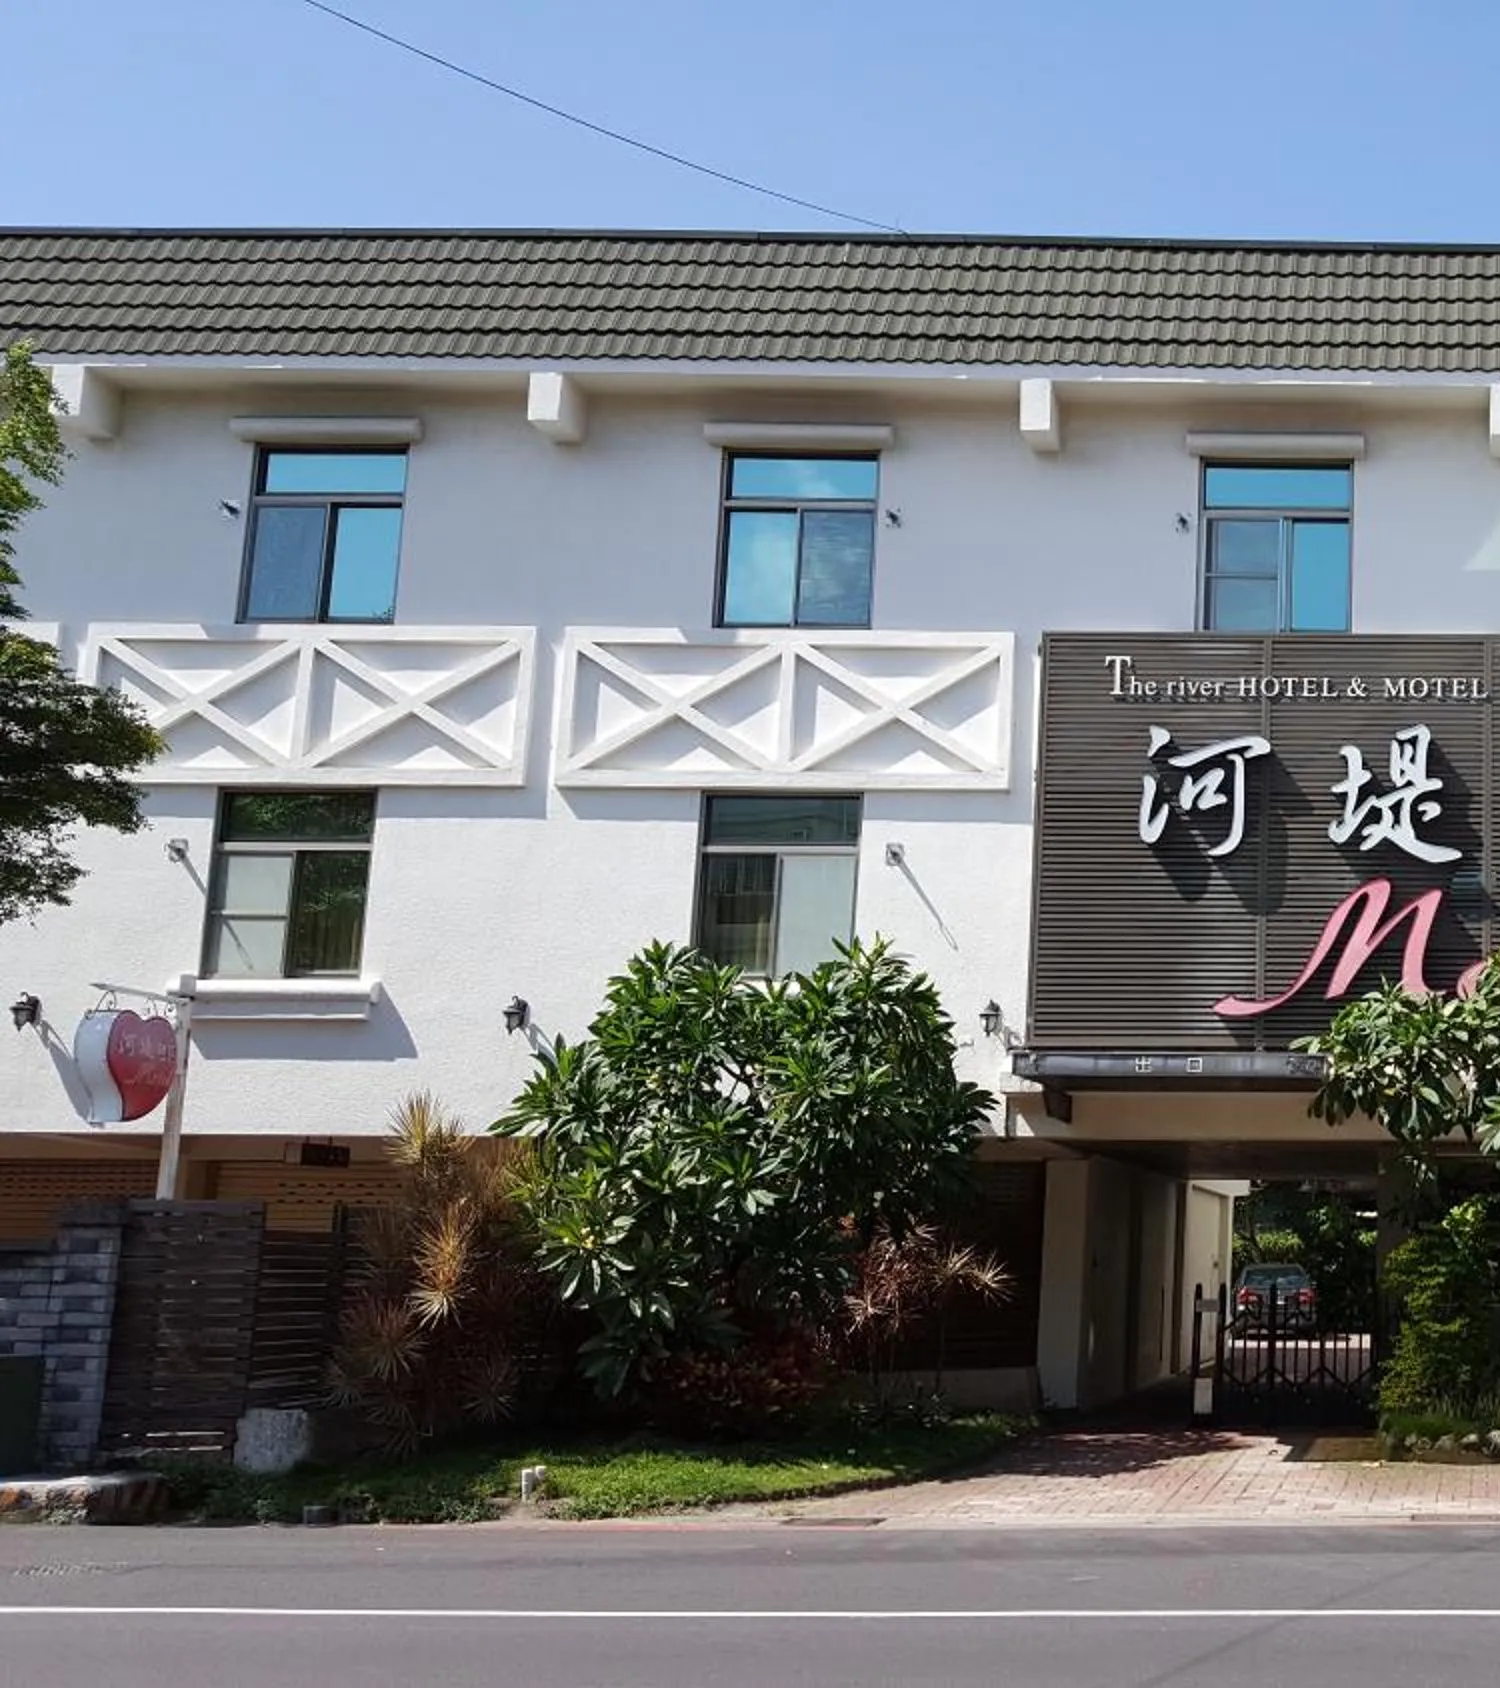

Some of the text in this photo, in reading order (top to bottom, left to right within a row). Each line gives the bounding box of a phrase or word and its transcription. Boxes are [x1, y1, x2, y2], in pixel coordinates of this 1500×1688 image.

[1104, 655, 1489, 698] The river HOTEL & MOTEL
[1135, 1056, 1203, 1073] 出口
